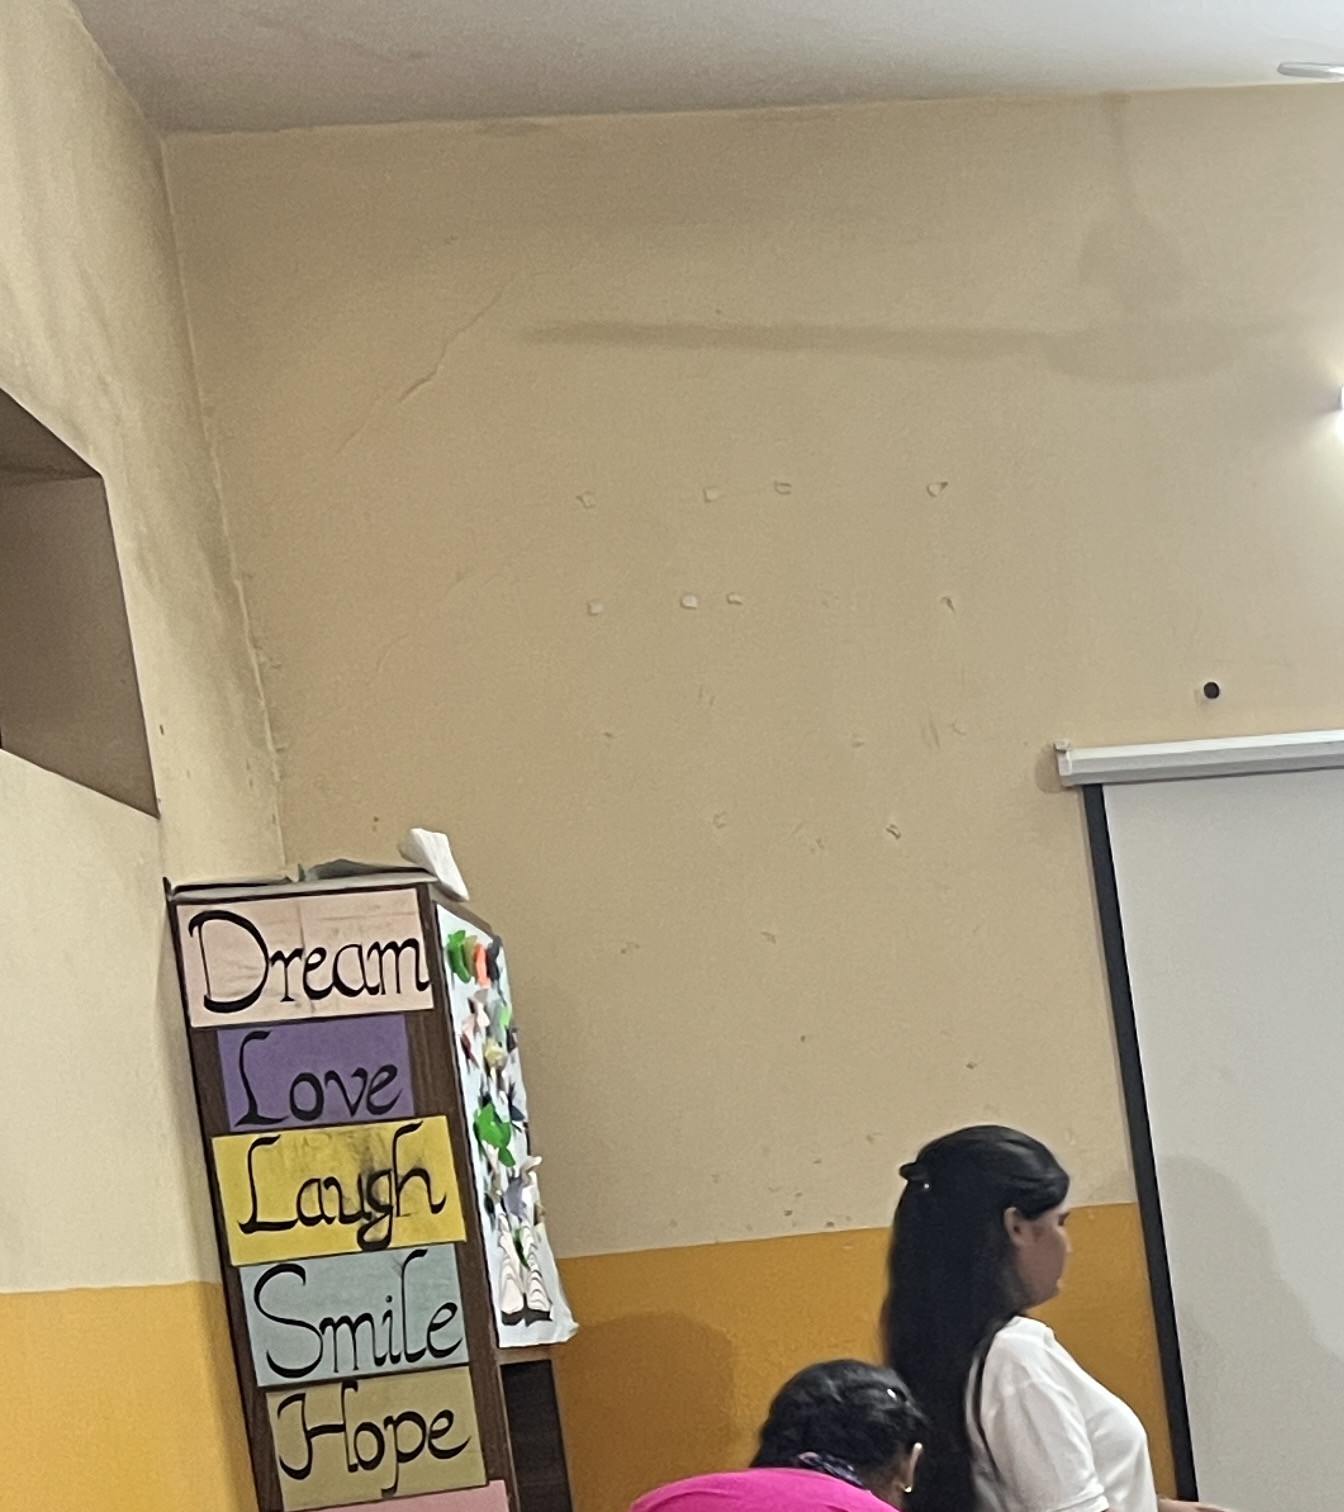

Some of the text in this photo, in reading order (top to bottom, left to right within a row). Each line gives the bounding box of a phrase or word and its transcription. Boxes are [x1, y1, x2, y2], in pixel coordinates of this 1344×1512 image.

[189, 909, 430, 1013] Dream
[237, 1031, 403, 1126] Love
[238, 1123, 447, 1251] Laugh
[253, 1250, 464, 1380] Smile
[278, 1383, 471, 1496] Hope
